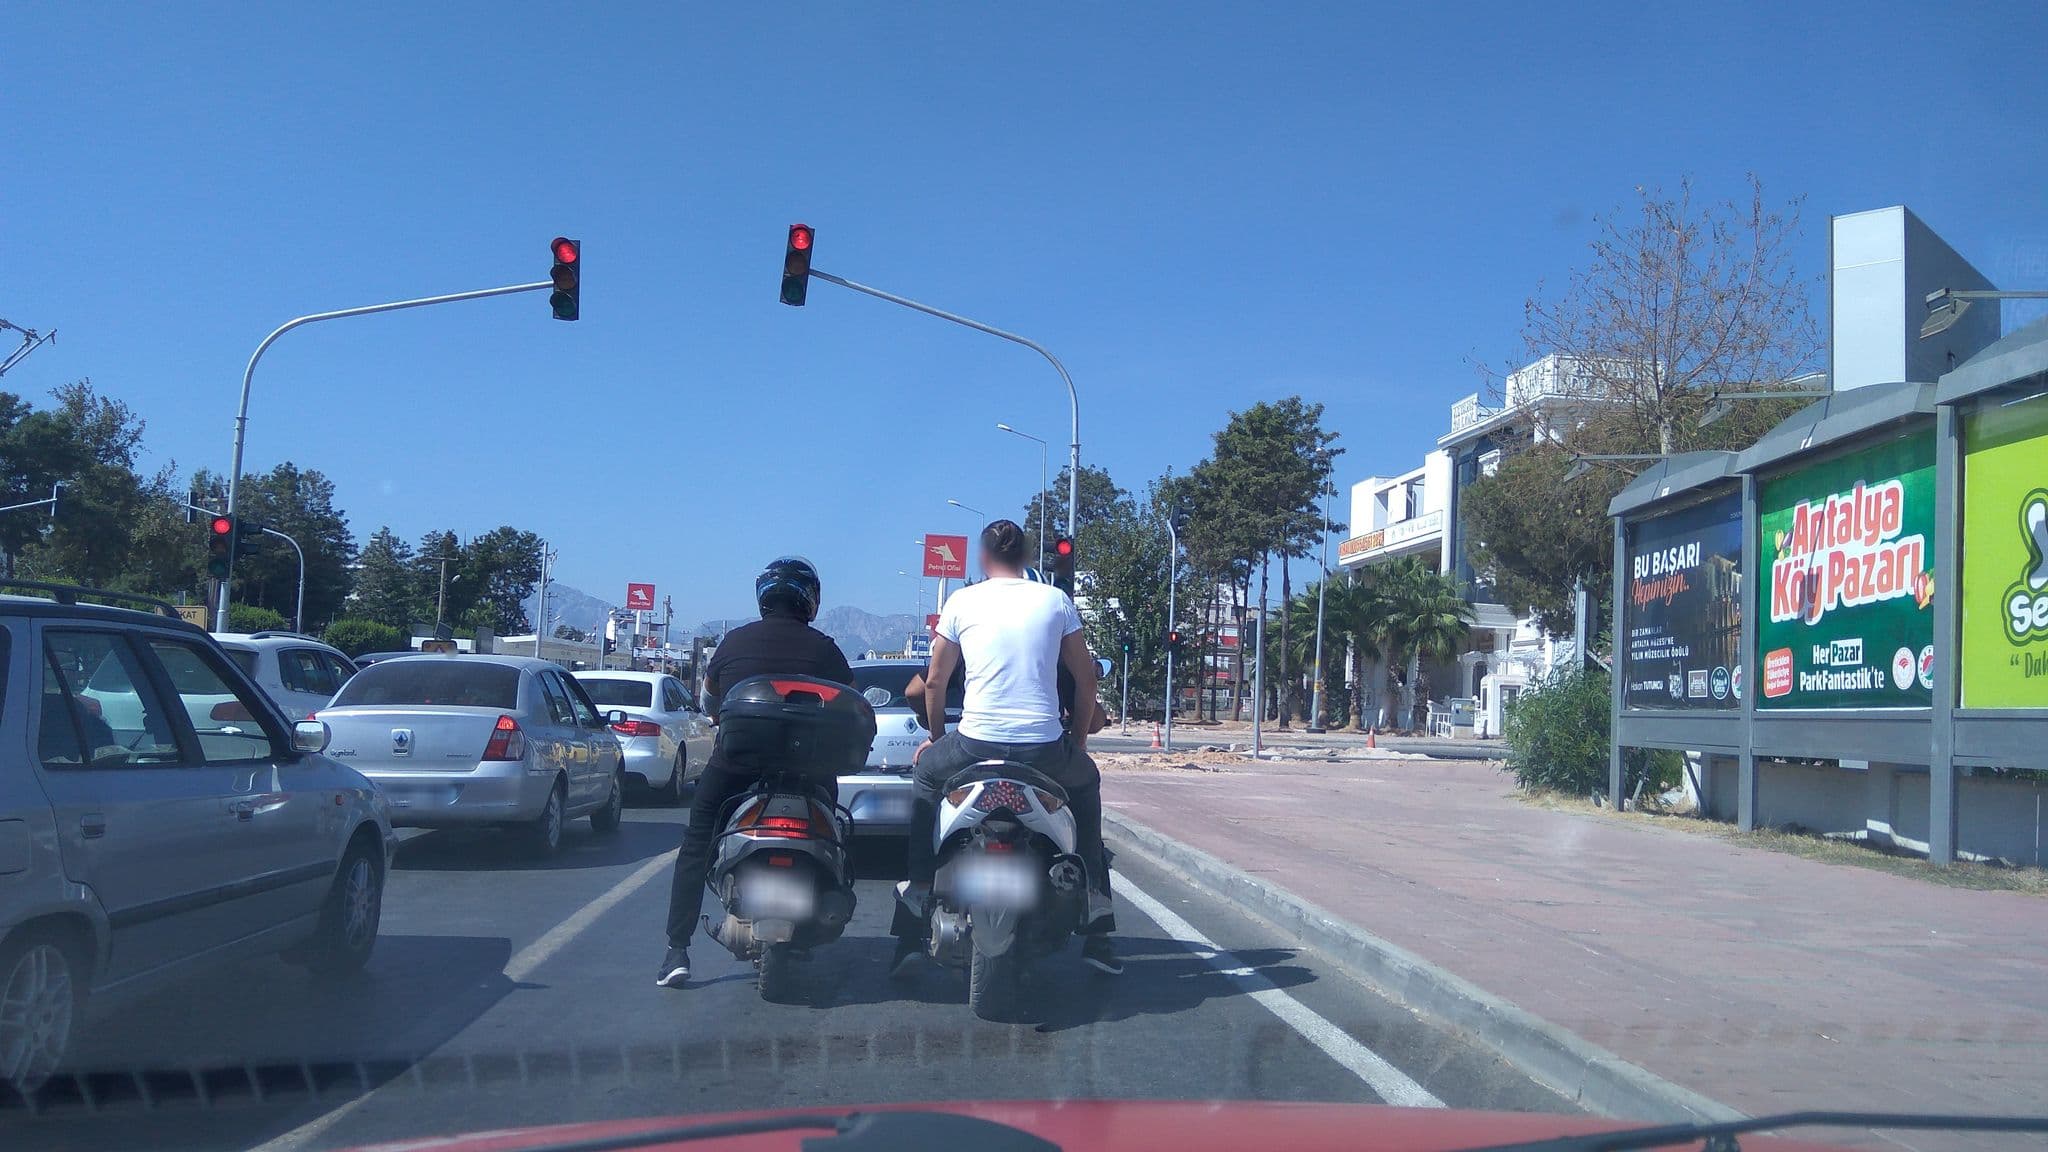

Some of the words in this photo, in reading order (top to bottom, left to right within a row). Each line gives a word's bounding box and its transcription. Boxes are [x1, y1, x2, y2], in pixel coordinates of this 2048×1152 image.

[1792, 485, 1900, 557] Antalya
[1634, 554, 1650, 580] BU
[1652, 542, 1700, 576] BAŞARI
[1773, 559, 1823, 619] Köy
[1827, 542, 1921, 604] Pazarı
[1812, 644, 1830, 665] Her
[1832, 643, 1861, 663] Pazar
[1799, 665, 1884, 691] ParkFantastik'te
